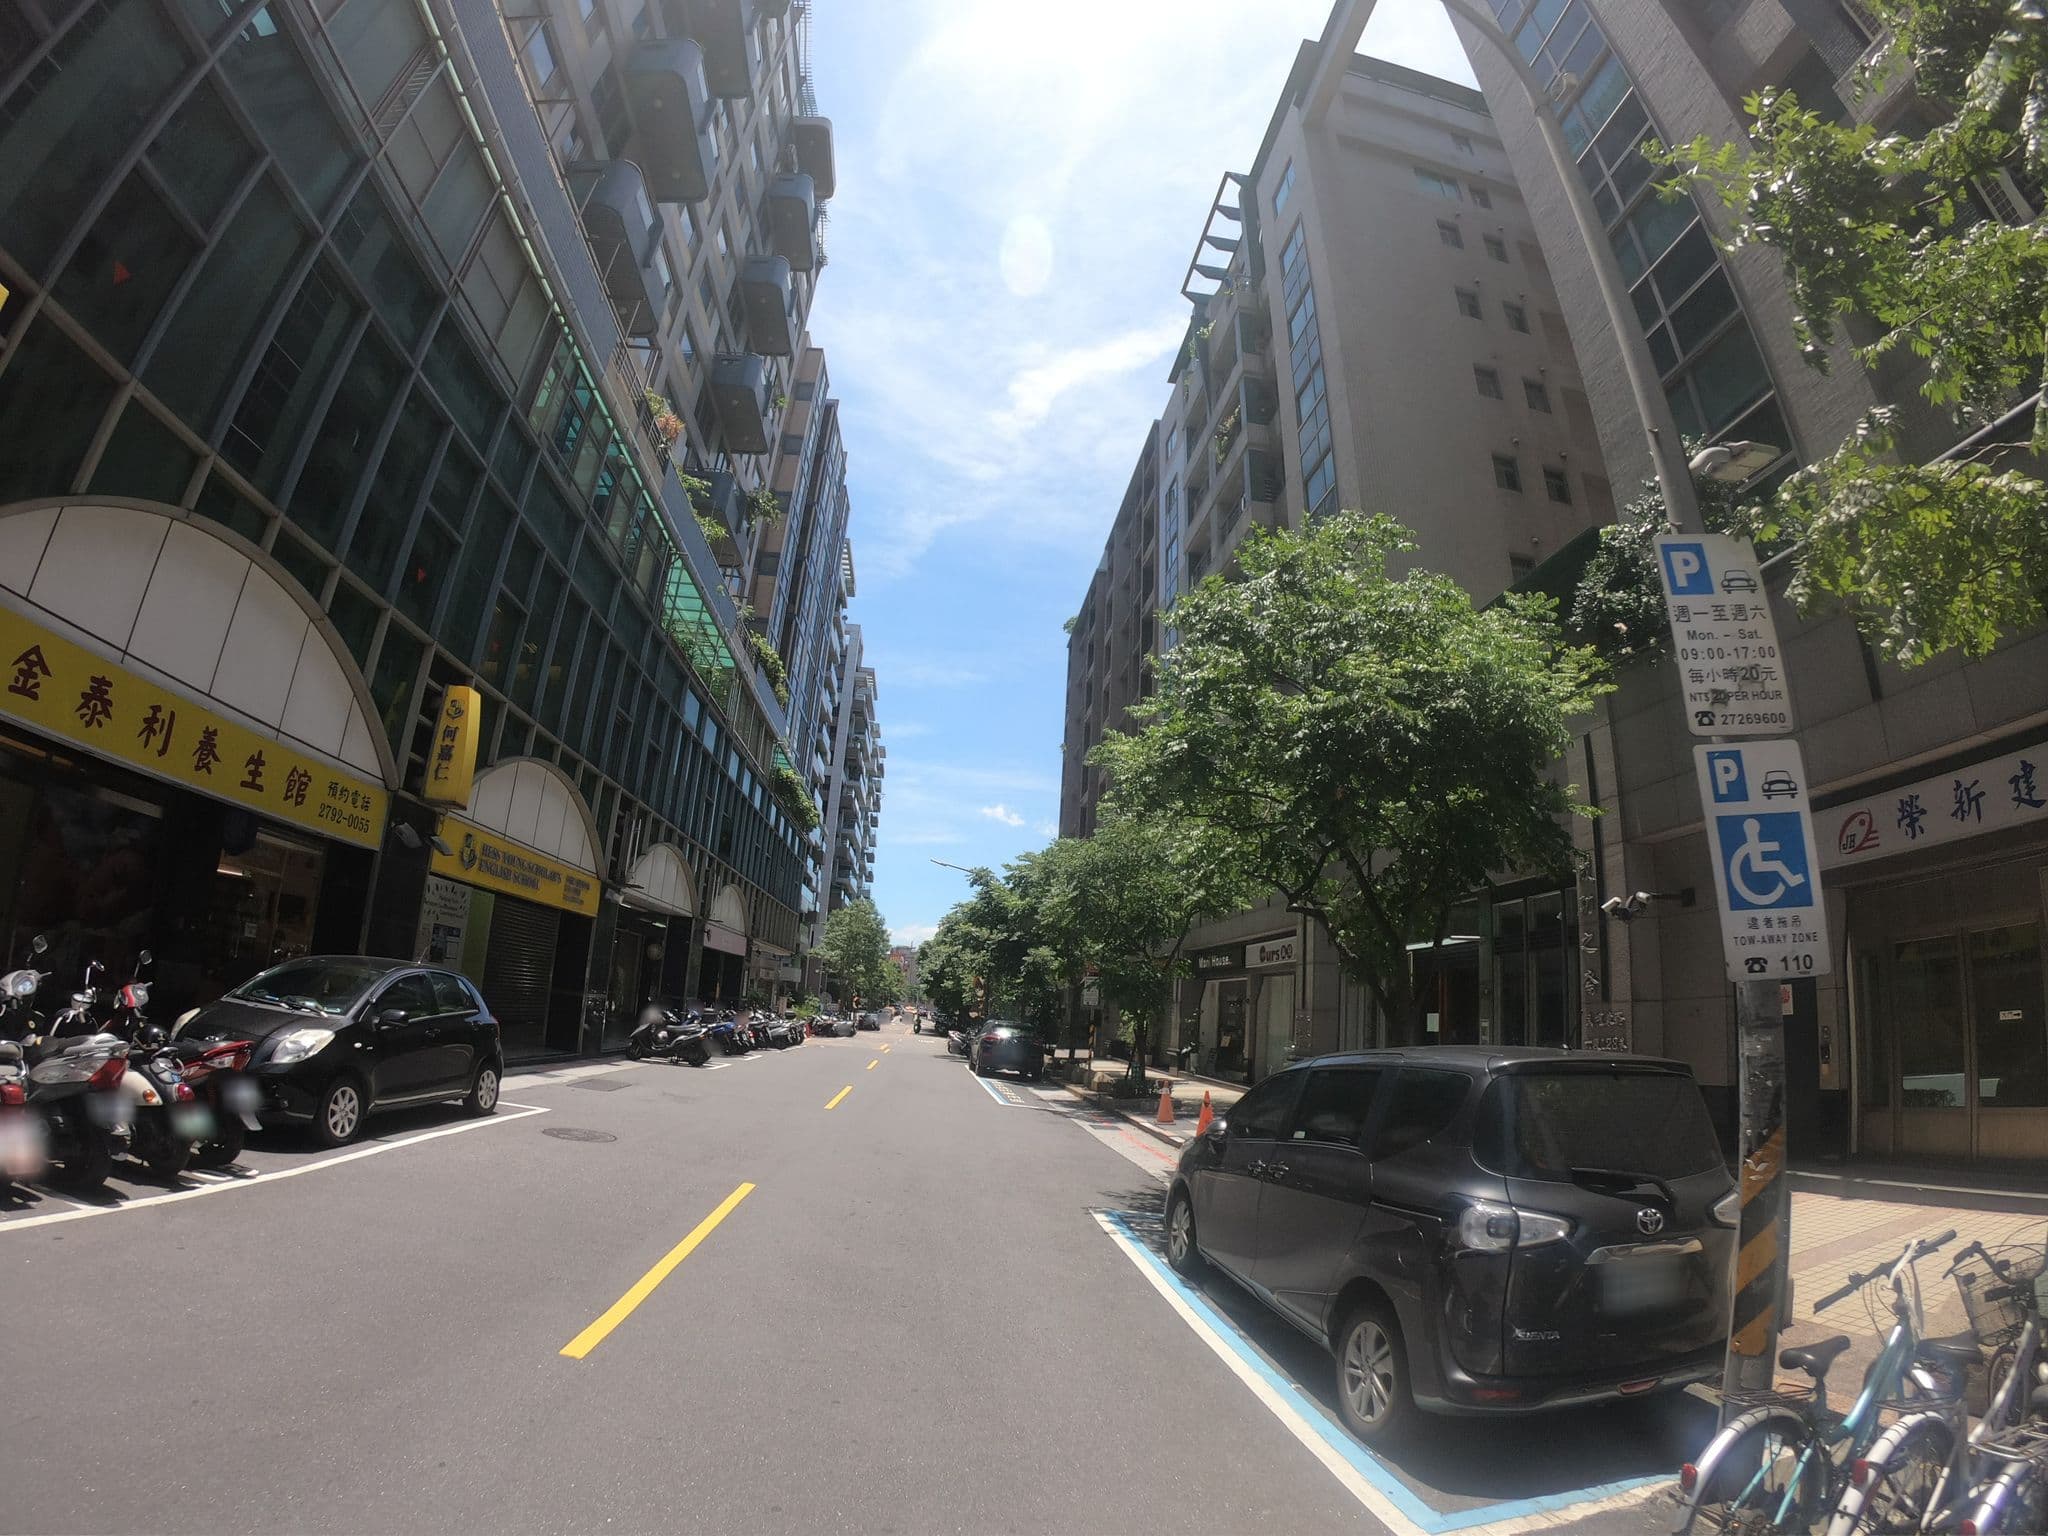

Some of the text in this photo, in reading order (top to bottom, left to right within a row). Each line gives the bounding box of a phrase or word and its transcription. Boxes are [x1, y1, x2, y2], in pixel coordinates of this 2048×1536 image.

[1670, 551, 1700, 587] P
[1672, 603, 1768, 623] 週一至週六
[1687, 630, 1718, 641] Mon.
[1681, 646, 1775, 660] 09:00-17:00
[1752, 690, 1783, 702] HOUR
[7, 644, 313, 808] 金泰利養生館
[1721, 712, 1786, 726] 27269600
[1714, 759, 1738, 795] P
[327, 781, 371, 812] 預約電話
[318, 803, 370, 834] 2792-0055
[1733, 932, 1818, 946] TOW-AWAY ZONE
[1779, 954, 1813, 972] 110
